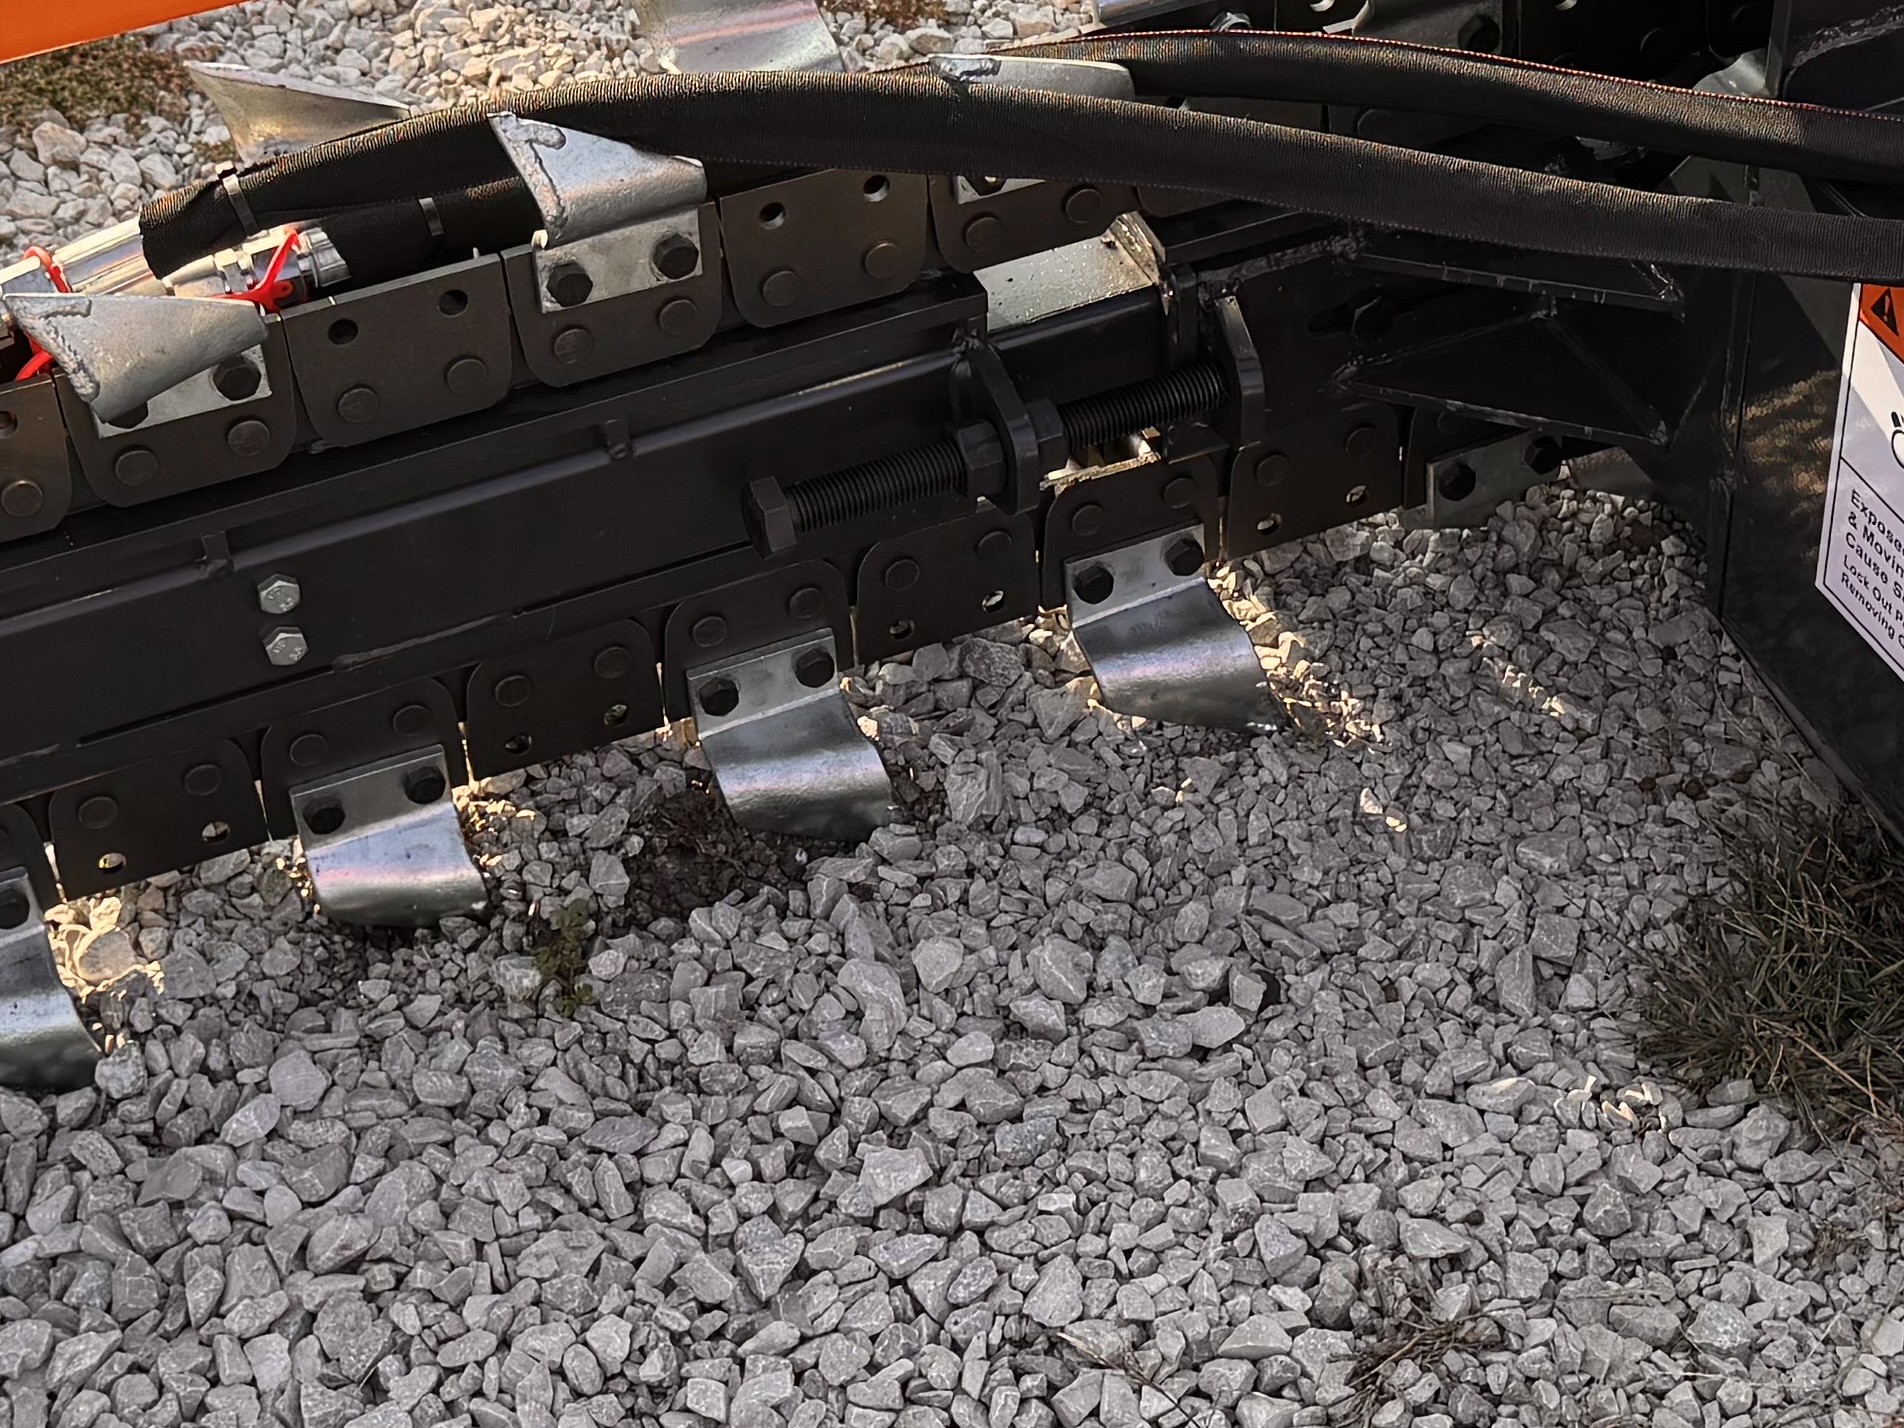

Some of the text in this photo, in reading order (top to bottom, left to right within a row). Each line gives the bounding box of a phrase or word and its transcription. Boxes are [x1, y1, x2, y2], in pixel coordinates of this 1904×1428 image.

[1847, 510, 1858, 531] &
[1843, 554, 1870, 591] Lock
[1872, 585, 1894, 616] Out
[1845, 531, 1889, 585] Cause
[1840, 572, 1896, 641] Removing
